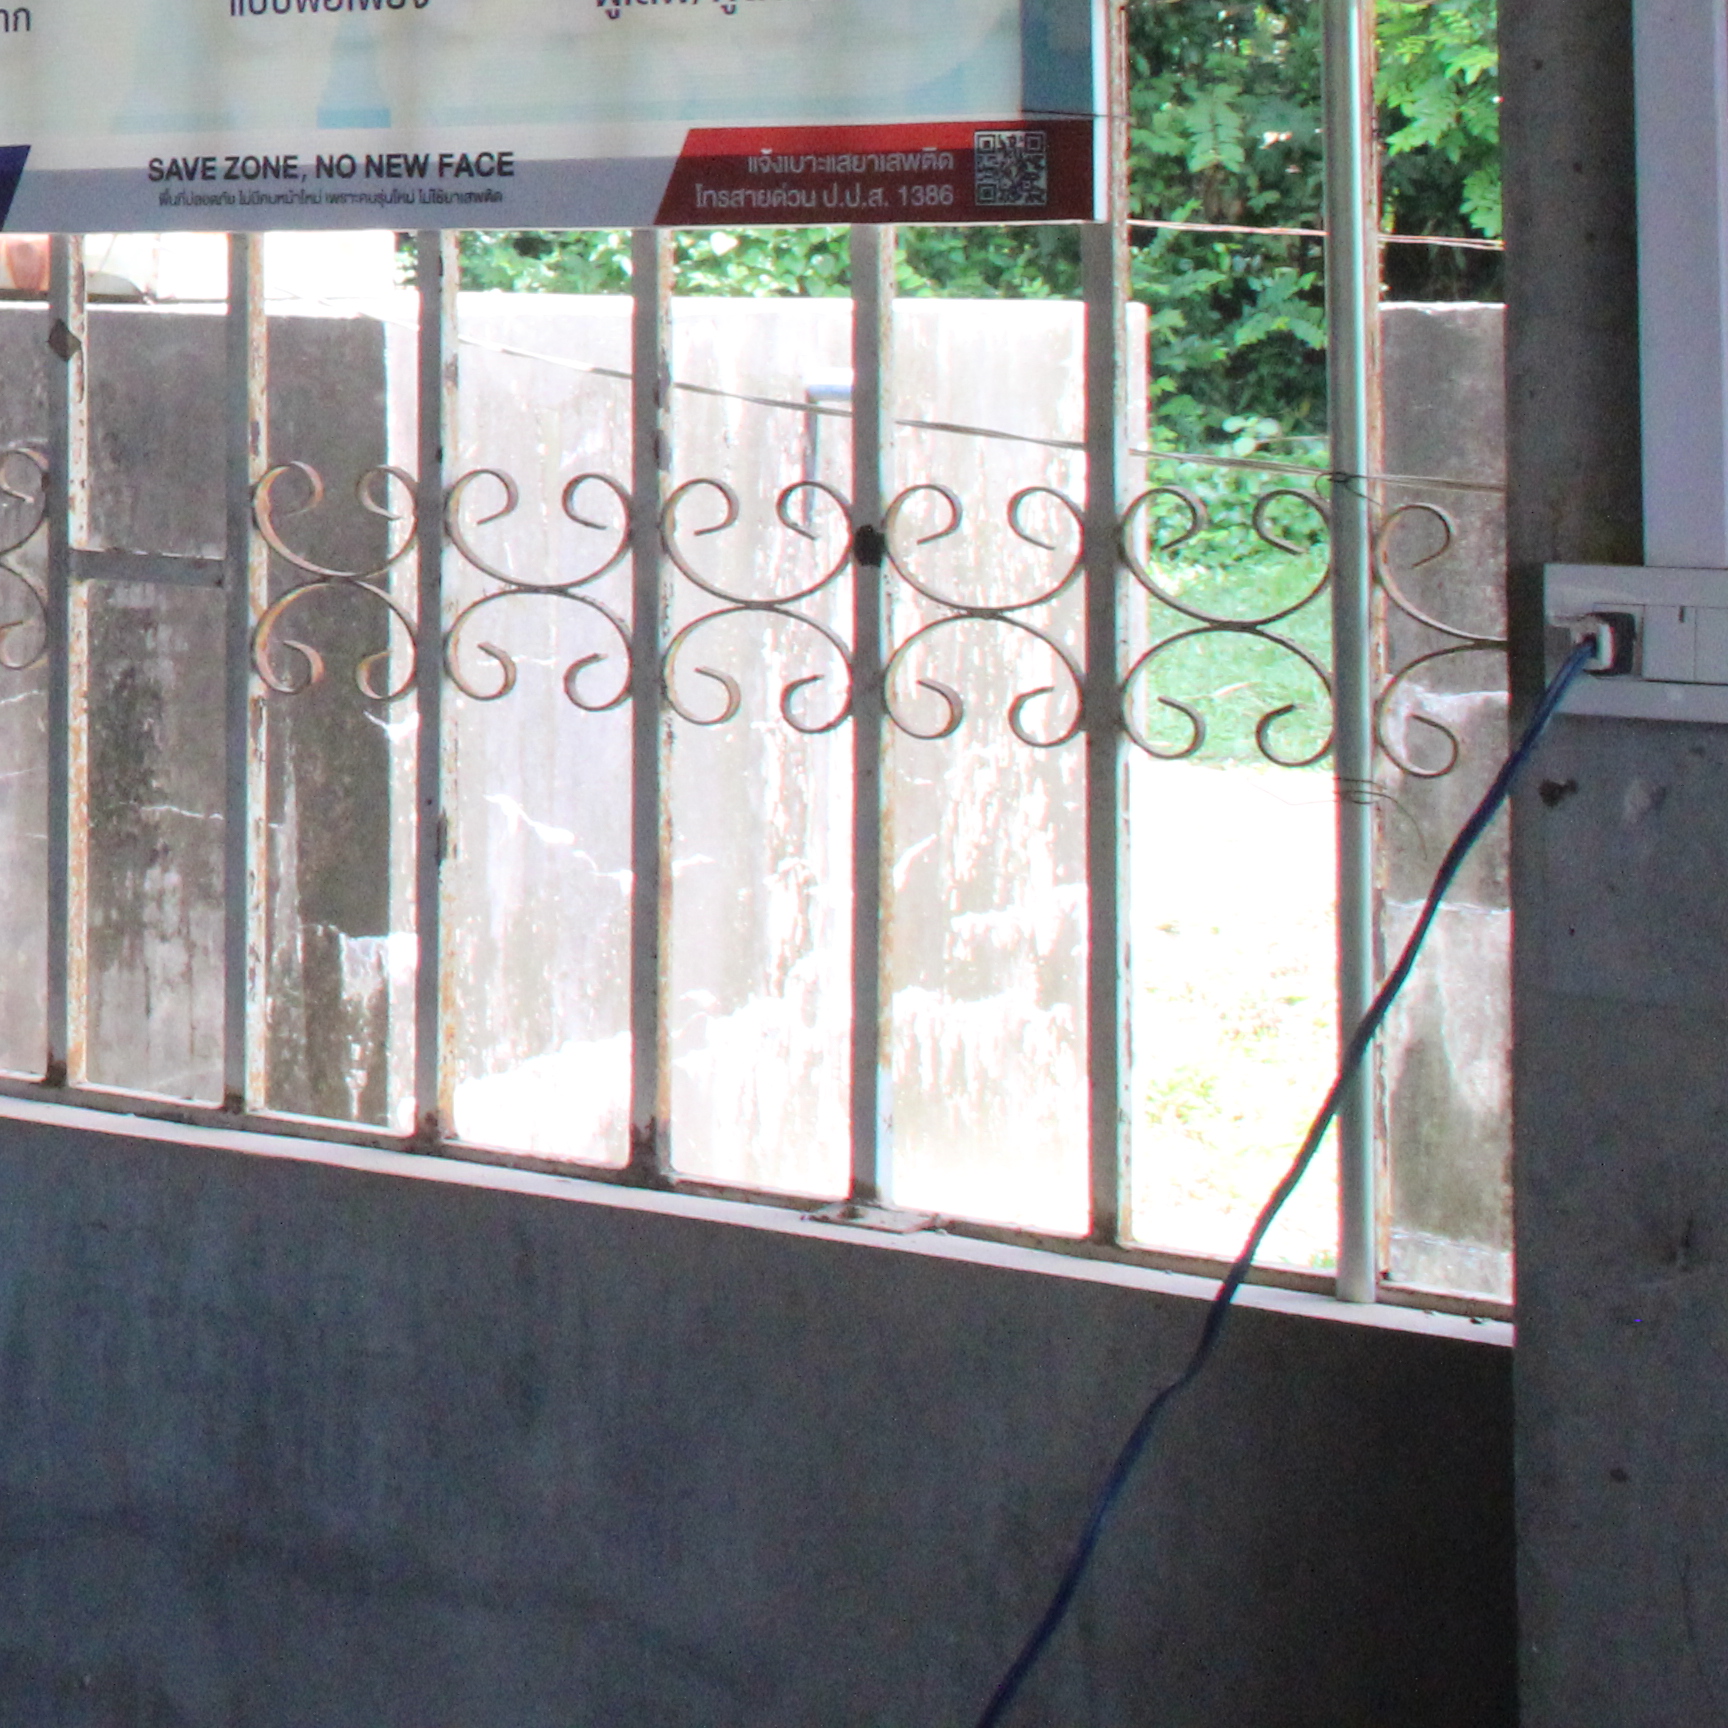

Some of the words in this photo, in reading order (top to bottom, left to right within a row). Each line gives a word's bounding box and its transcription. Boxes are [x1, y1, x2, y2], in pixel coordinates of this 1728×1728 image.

[148, 157, 217, 182] SAVE
[315, 154, 357, 180] NO
[364, 153, 431, 179] NEW
[438, 152, 515, 178] FACE
[898, 184, 955, 208] 1386
